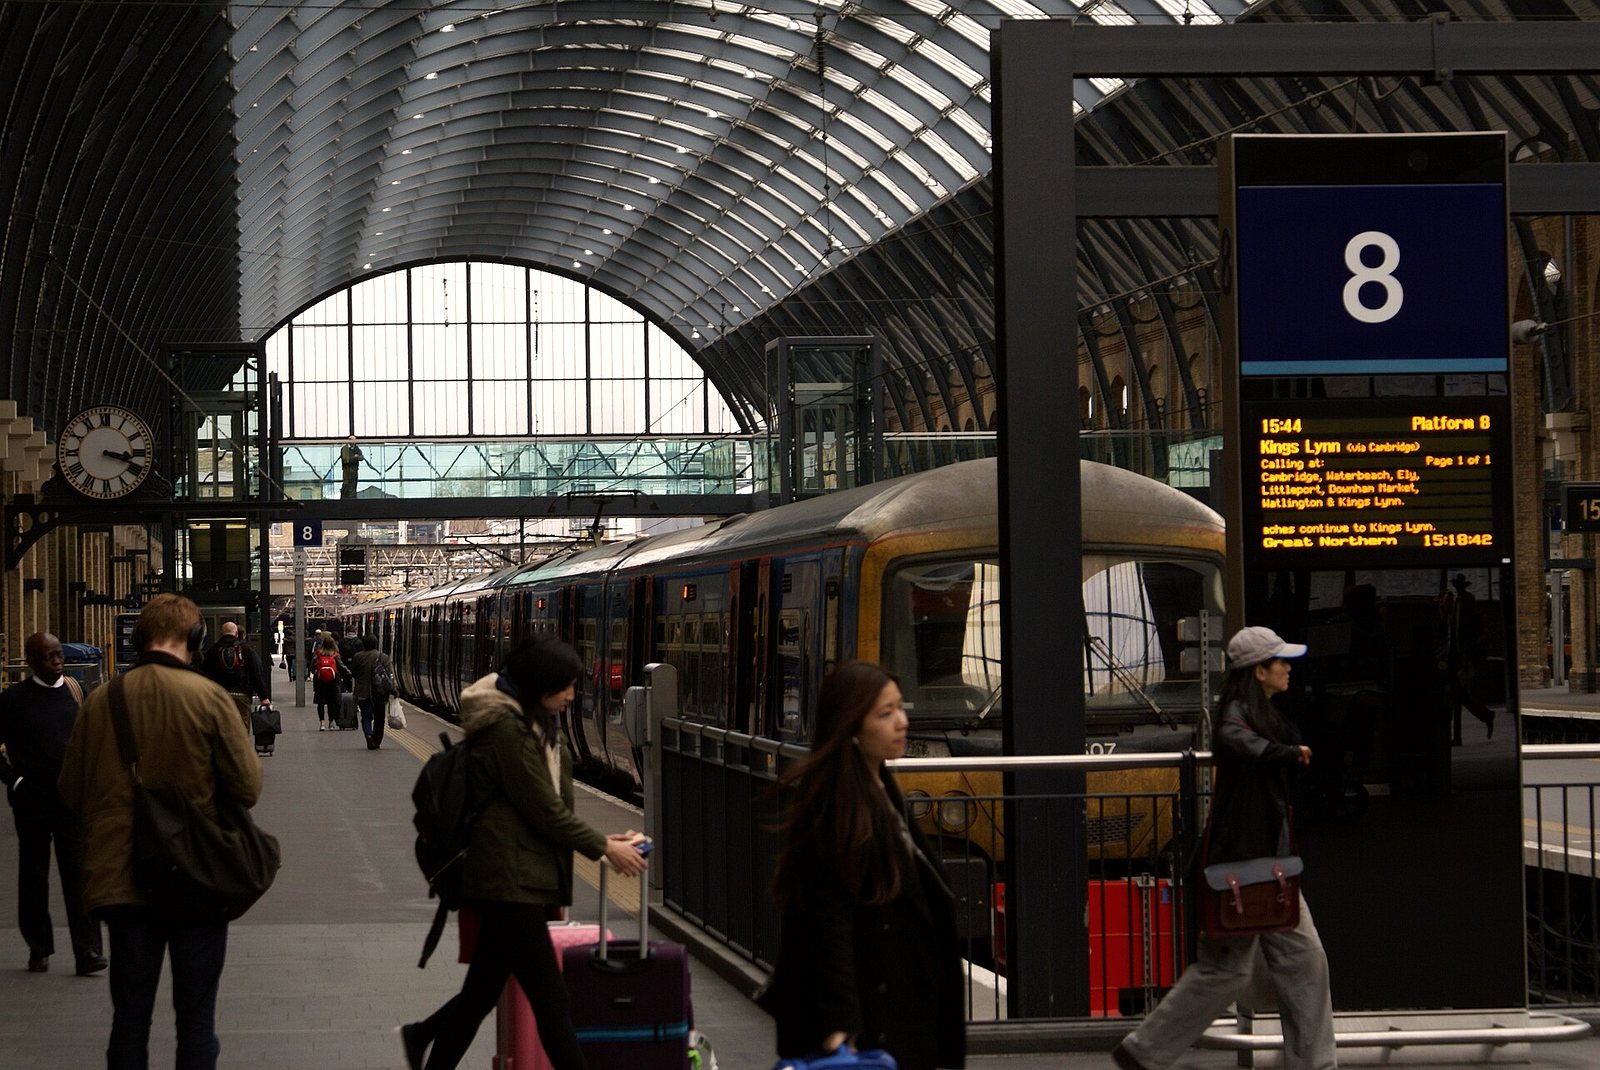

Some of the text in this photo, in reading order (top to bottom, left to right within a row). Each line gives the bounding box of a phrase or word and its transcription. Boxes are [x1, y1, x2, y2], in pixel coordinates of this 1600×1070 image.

[1343, 231, 1404, 324] 8
[1262, 418, 1302, 434] 15:44
[1412, 415, 1491, 431] Platform 8
[1260, 438, 1420, 456] Kings Lynn (via Cambridge)
[1261, 458, 1325, 471] Calling at:
[1425, 455, 1491, 468] Page 1 of 1
[1261, 469, 1420, 484] Cambridge, Waterbeach, Ely,
[1261, 483, 1419, 497] Littleport, Downham Market,
[1262, 496, 1405, 510] Watlington & Kings Lynn.
[303, 526, 312, 540] 8
[1299, 522, 1349, 534] continue
[1353, 522, 1366, 533] to
[1369, 521, 1403, 533] Kings
[1405, 521, 1436, 533] Lynn.
[1263, 535, 1397, 548] Great Northern
[1424, 534, 1492, 547] 15:18:42
[1085, 742, 1116, 756] 07
